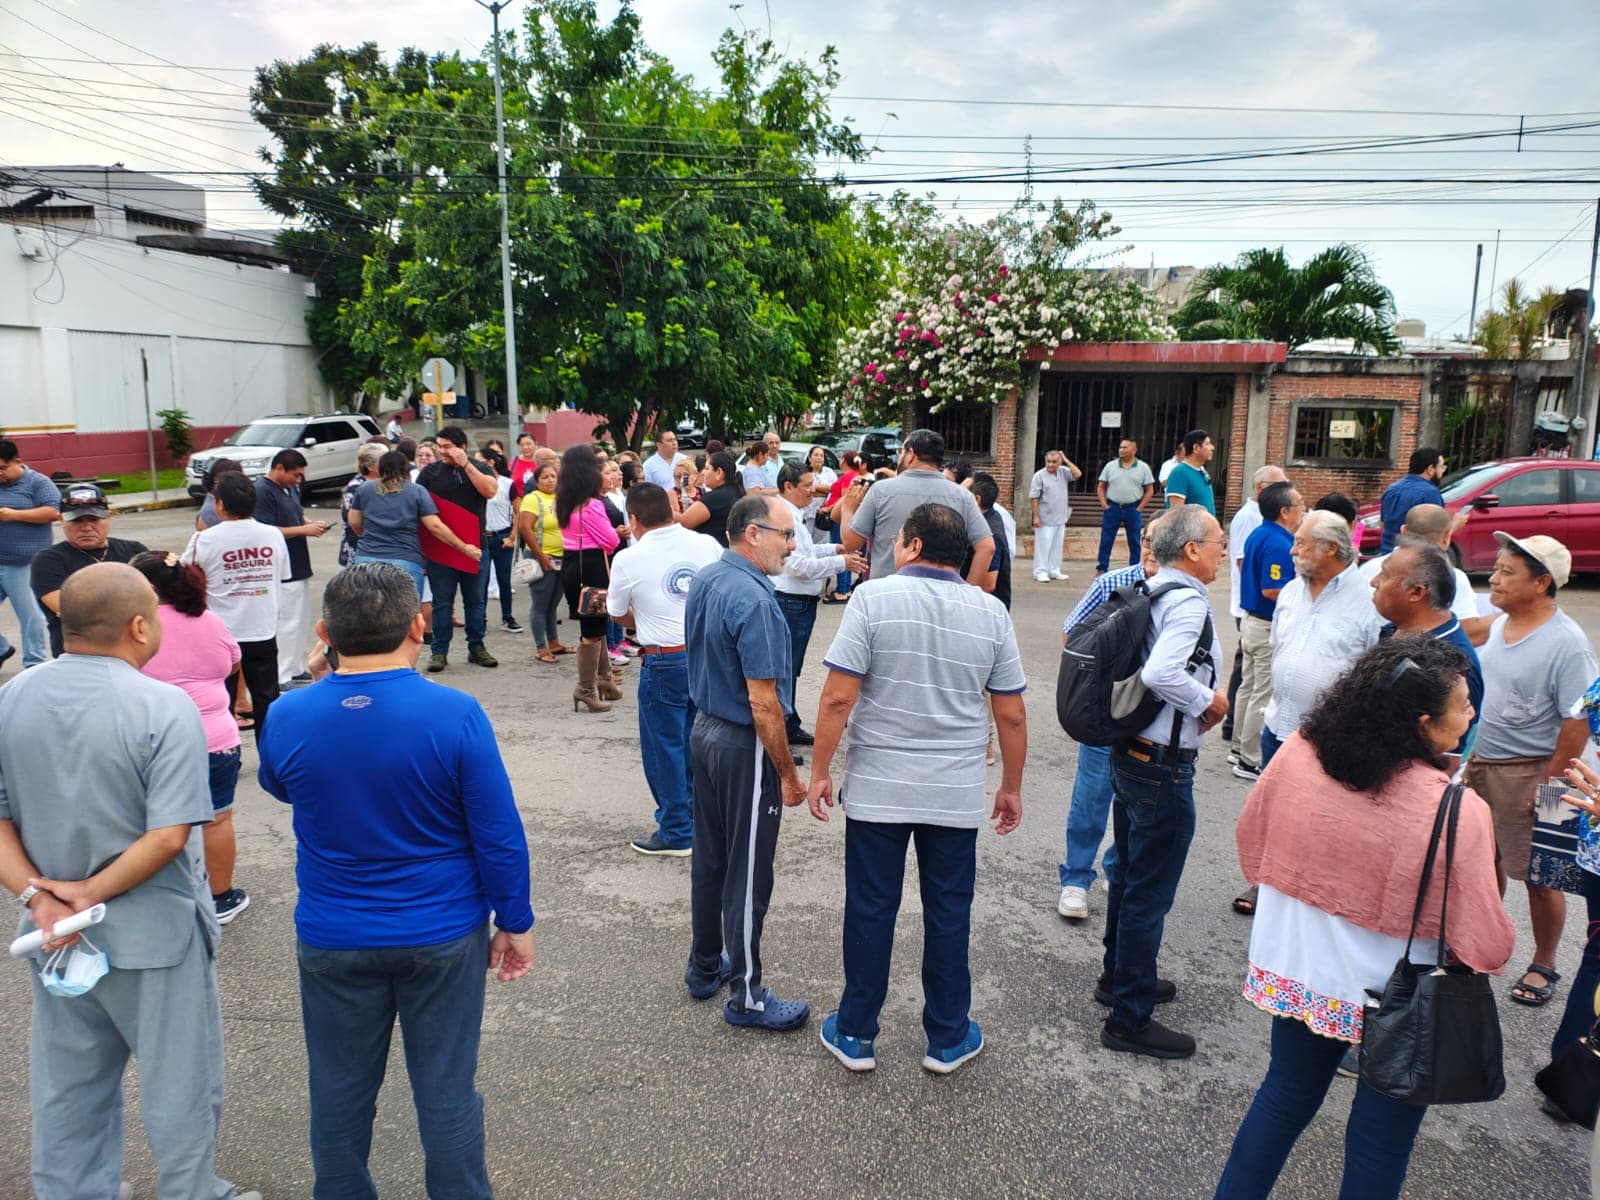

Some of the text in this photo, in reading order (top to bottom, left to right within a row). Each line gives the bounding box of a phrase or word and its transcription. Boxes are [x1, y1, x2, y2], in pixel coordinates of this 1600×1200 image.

[222, 546, 273, 563] GINO
[224, 560, 273, 571] SEGURA
[1270, 563, 1281, 580] 5
